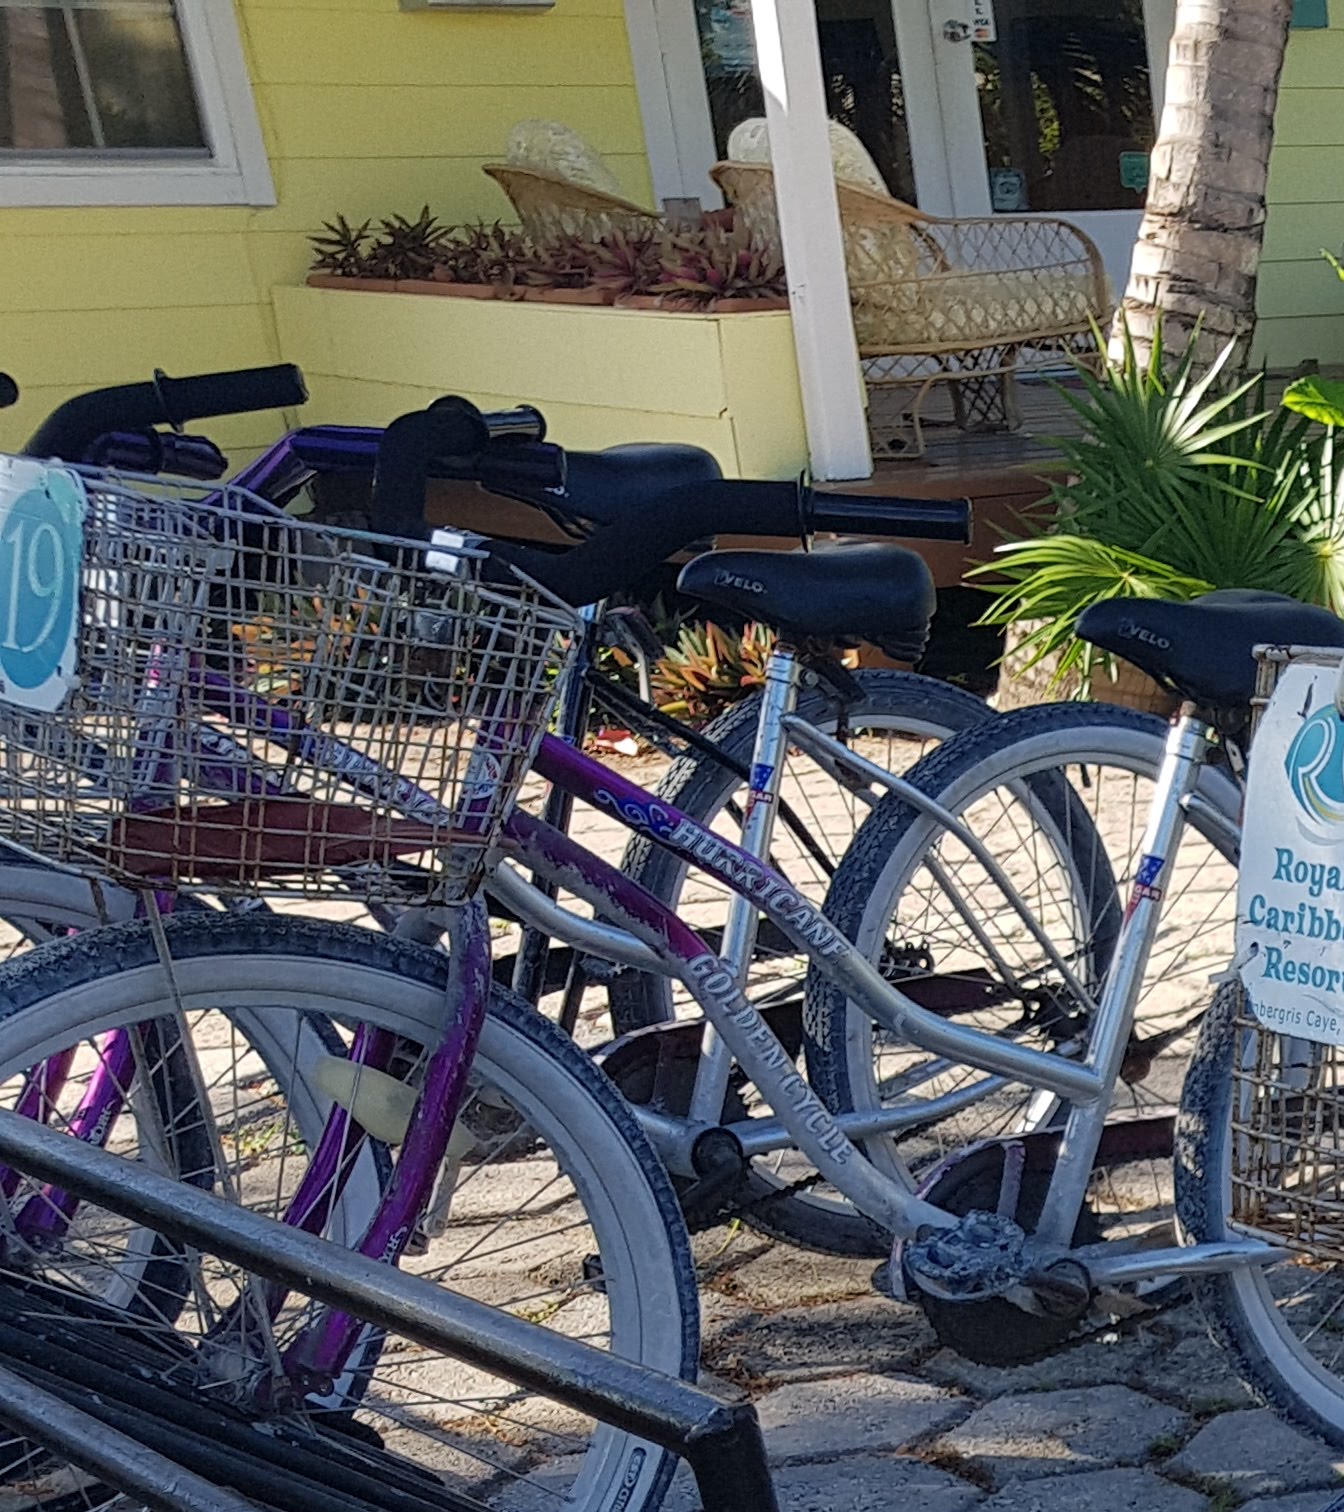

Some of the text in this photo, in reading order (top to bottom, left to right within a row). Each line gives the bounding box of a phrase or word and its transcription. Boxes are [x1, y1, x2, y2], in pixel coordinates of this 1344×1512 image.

[2, 520, 64, 653] 19
[723, 570, 765, 594] VELO
[1130, 623, 1171, 650] VELO
[1306, 1010, 1341, 1036] Caye,
[690, 953, 852, 1165] GOLDEN CYCLE
